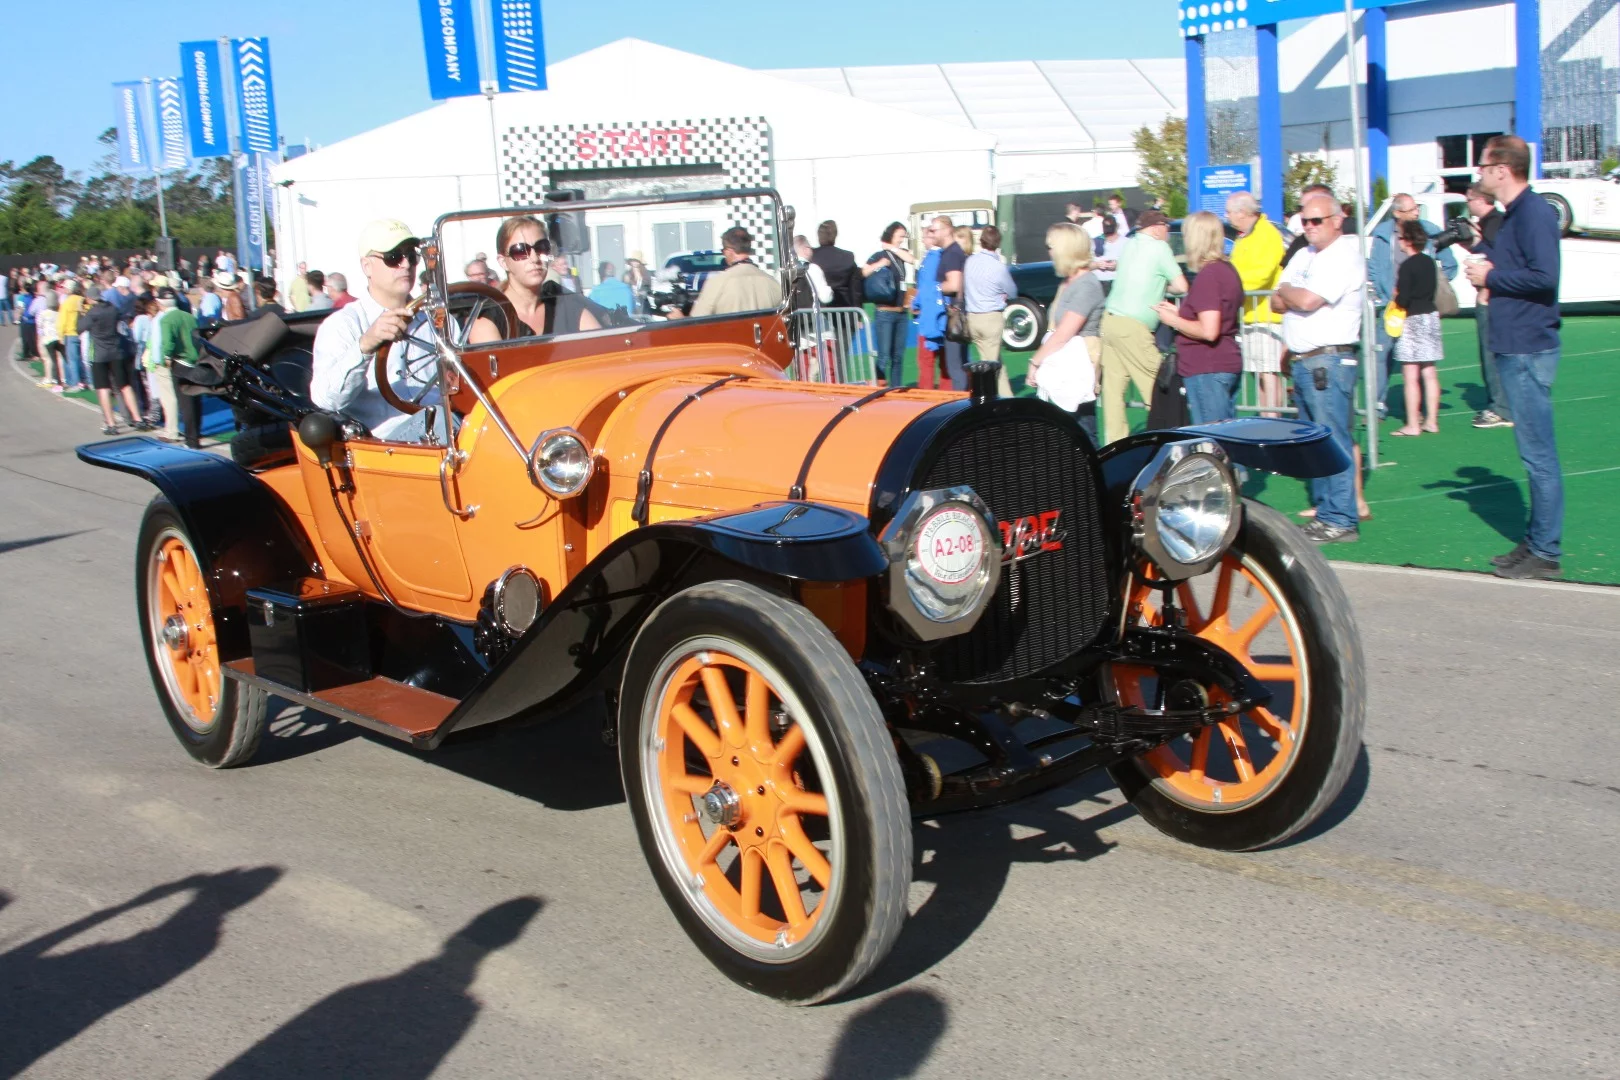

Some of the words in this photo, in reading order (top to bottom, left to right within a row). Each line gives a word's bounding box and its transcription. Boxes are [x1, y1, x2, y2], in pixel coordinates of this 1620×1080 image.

[194, 51, 215, 145] GOODING&COMPANY
[574, 128, 700, 160] START
[924, 512, 951, 538] PEBBLE
[935, 535, 974, 557] A2-08
